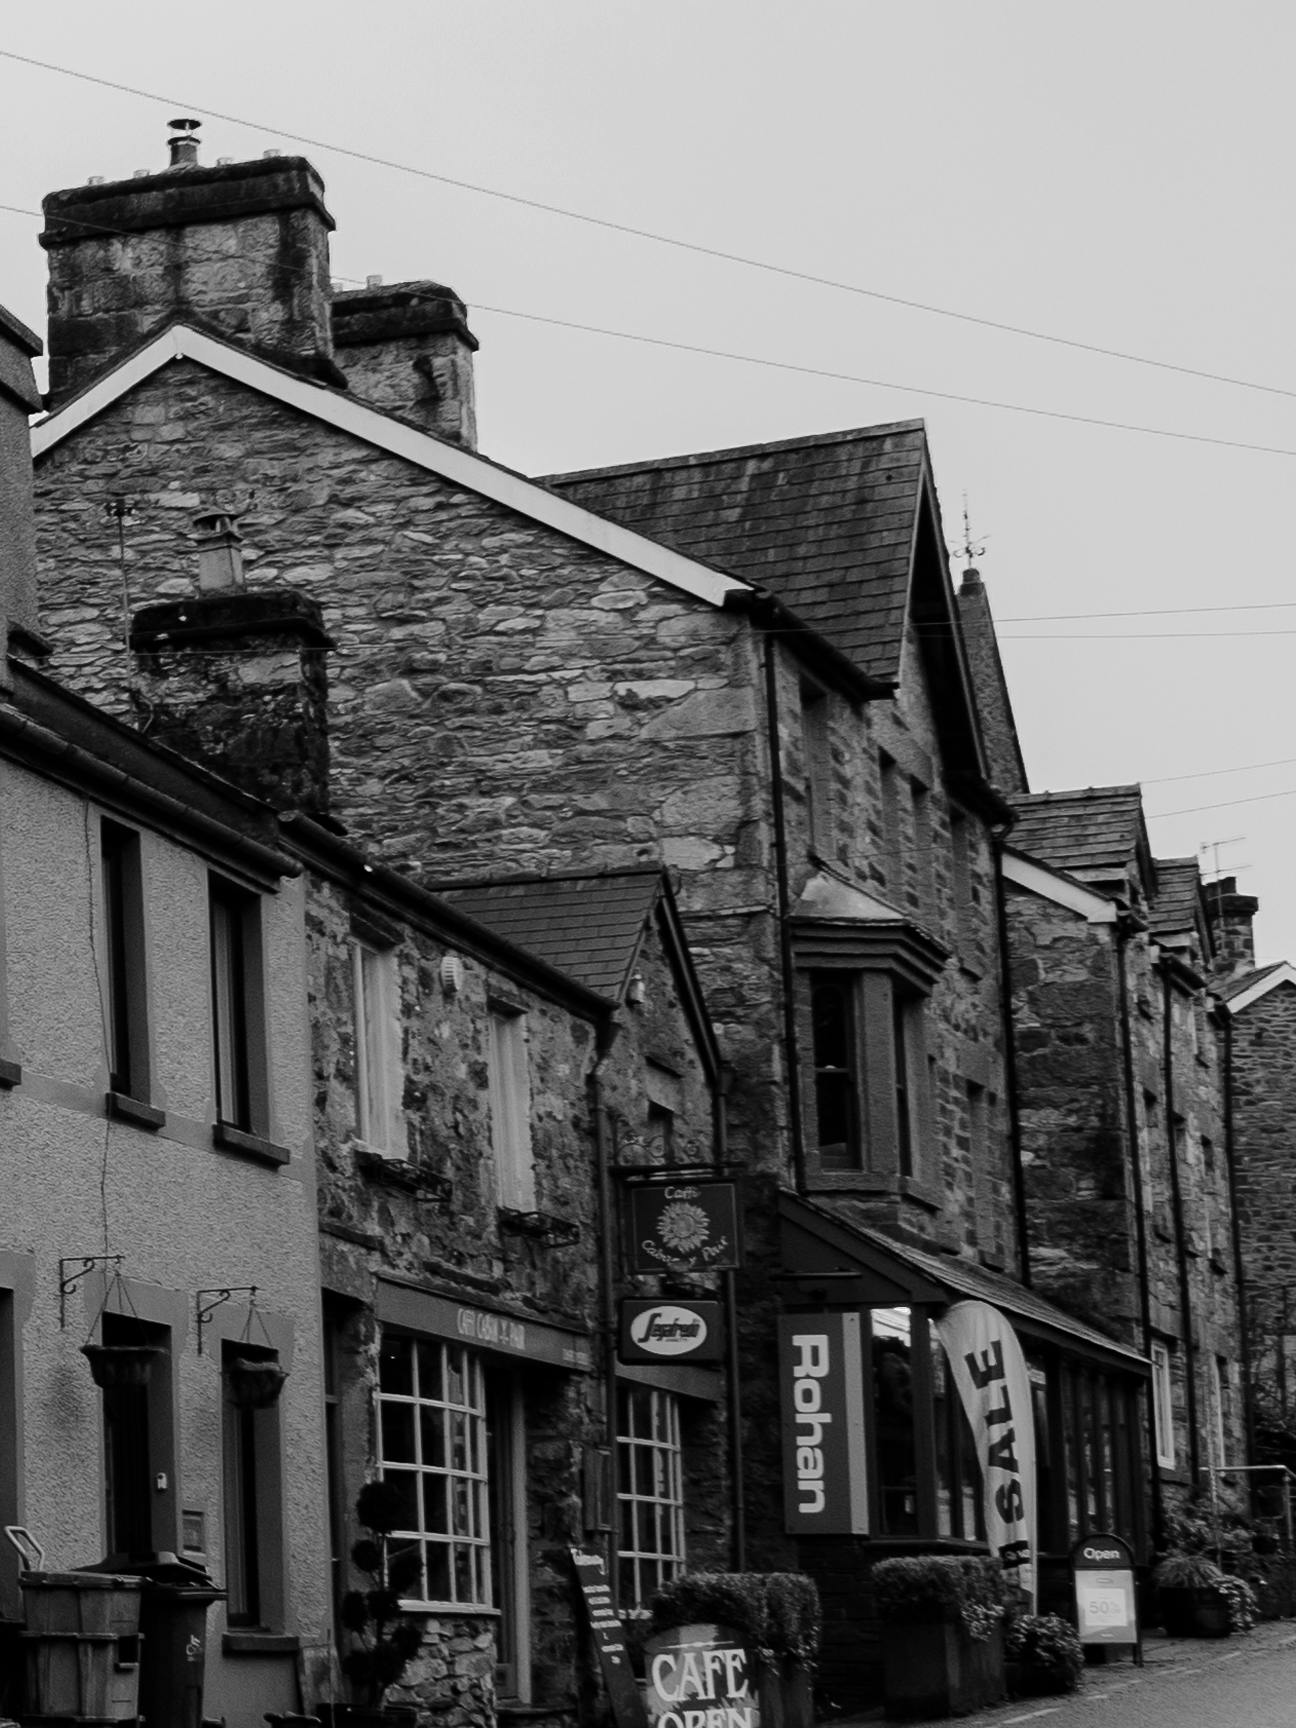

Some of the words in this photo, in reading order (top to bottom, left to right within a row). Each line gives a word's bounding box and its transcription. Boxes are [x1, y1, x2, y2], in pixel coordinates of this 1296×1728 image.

[791, 1333, 830, 1515] Rohan
[964, 1340, 1024, 1524] SALE
[1082, 1546, 1121, 1561] Open
[652, 1648, 749, 1702] CAFE
